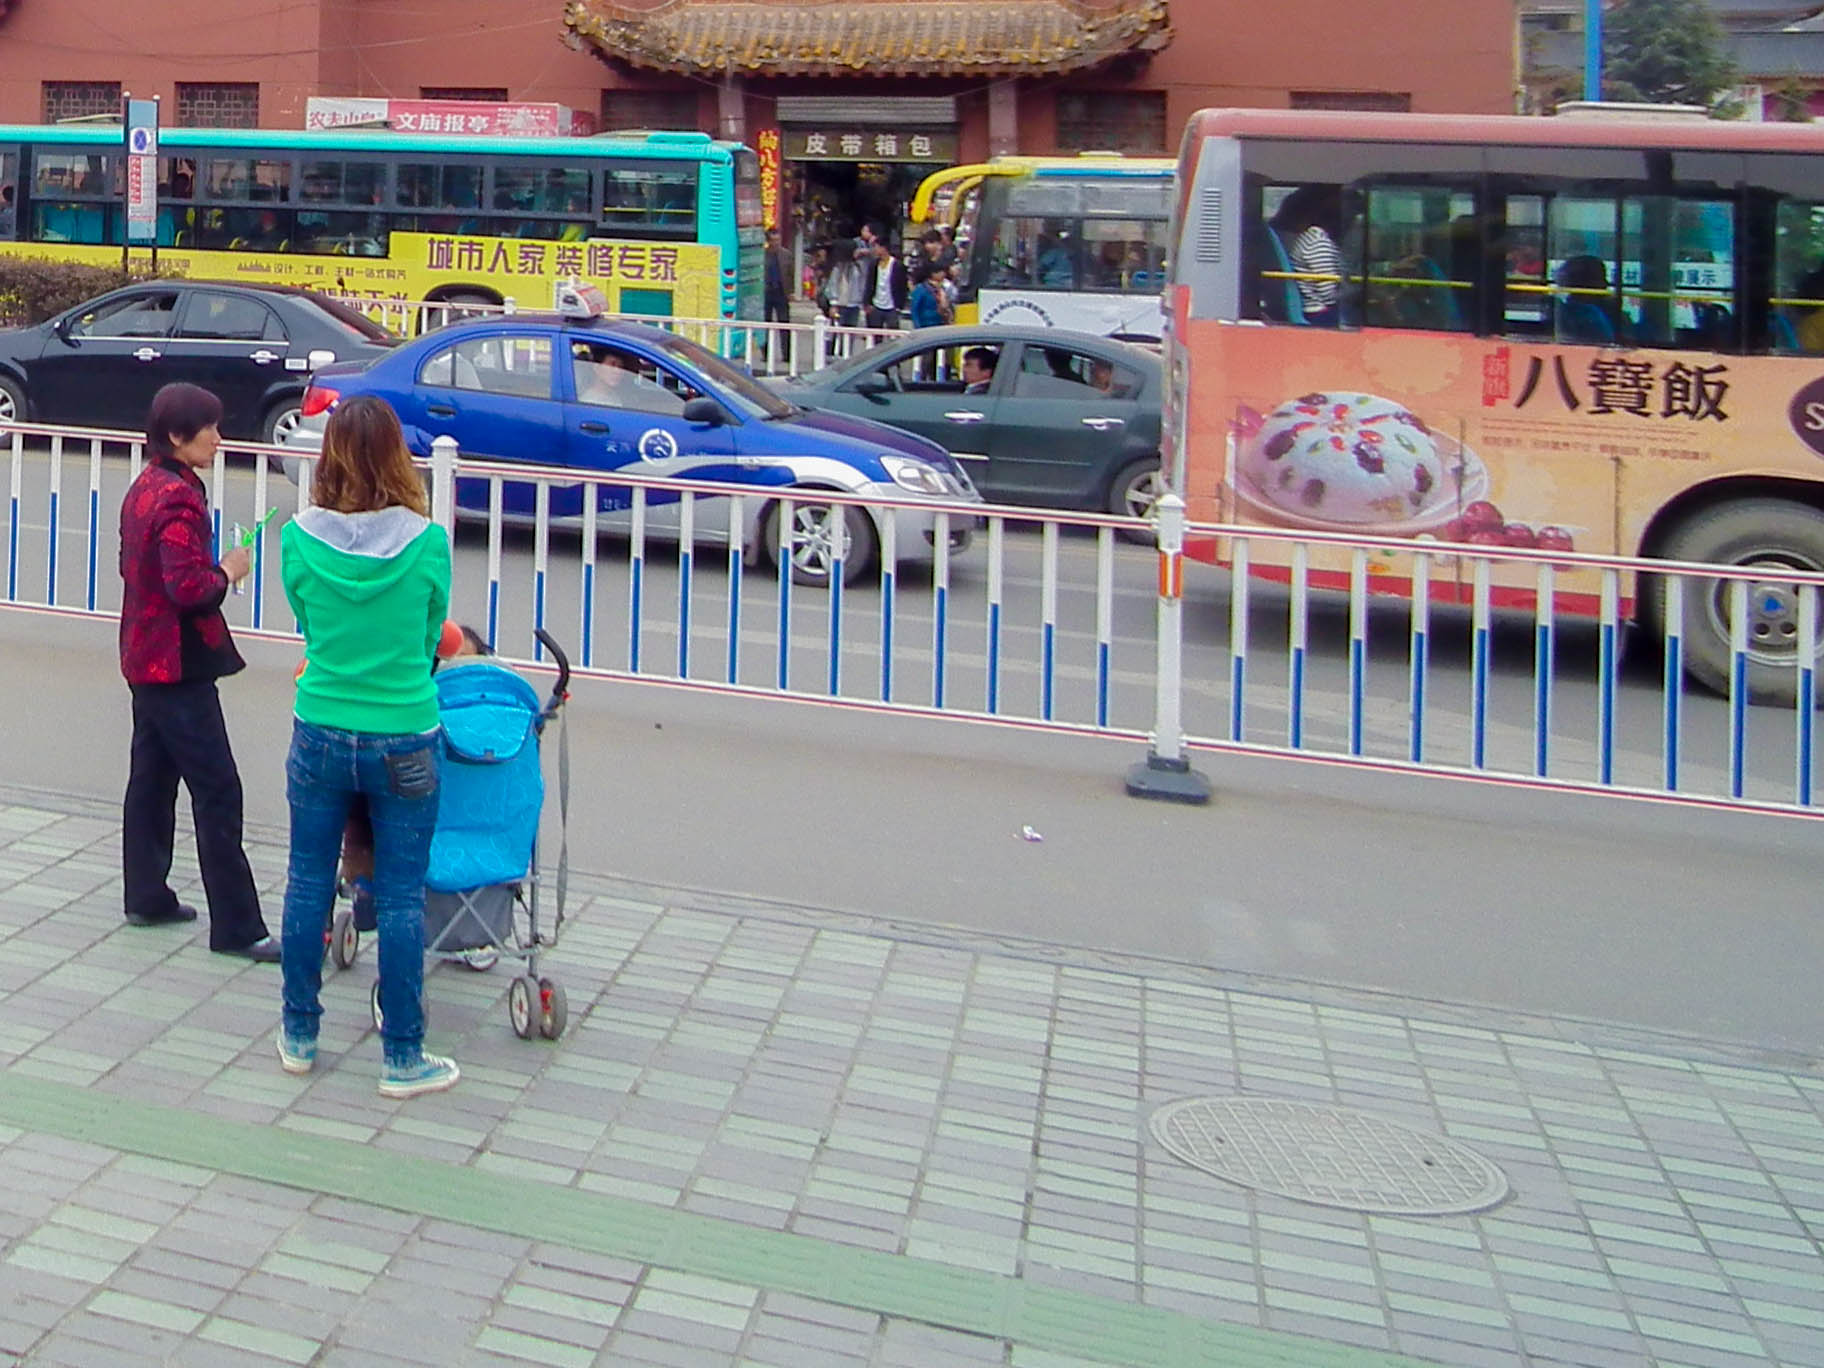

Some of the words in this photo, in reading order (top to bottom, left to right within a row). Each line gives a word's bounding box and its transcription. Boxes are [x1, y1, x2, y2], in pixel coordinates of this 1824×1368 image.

[395, 112, 489, 133] 文庙报亭
[805, 133, 932, 157] 皮带箱包
[427, 236, 545, 276] 城市人家
[555, 243, 678, 282] 装修专家
[1513, 355, 1729, 422] 八寶飯
